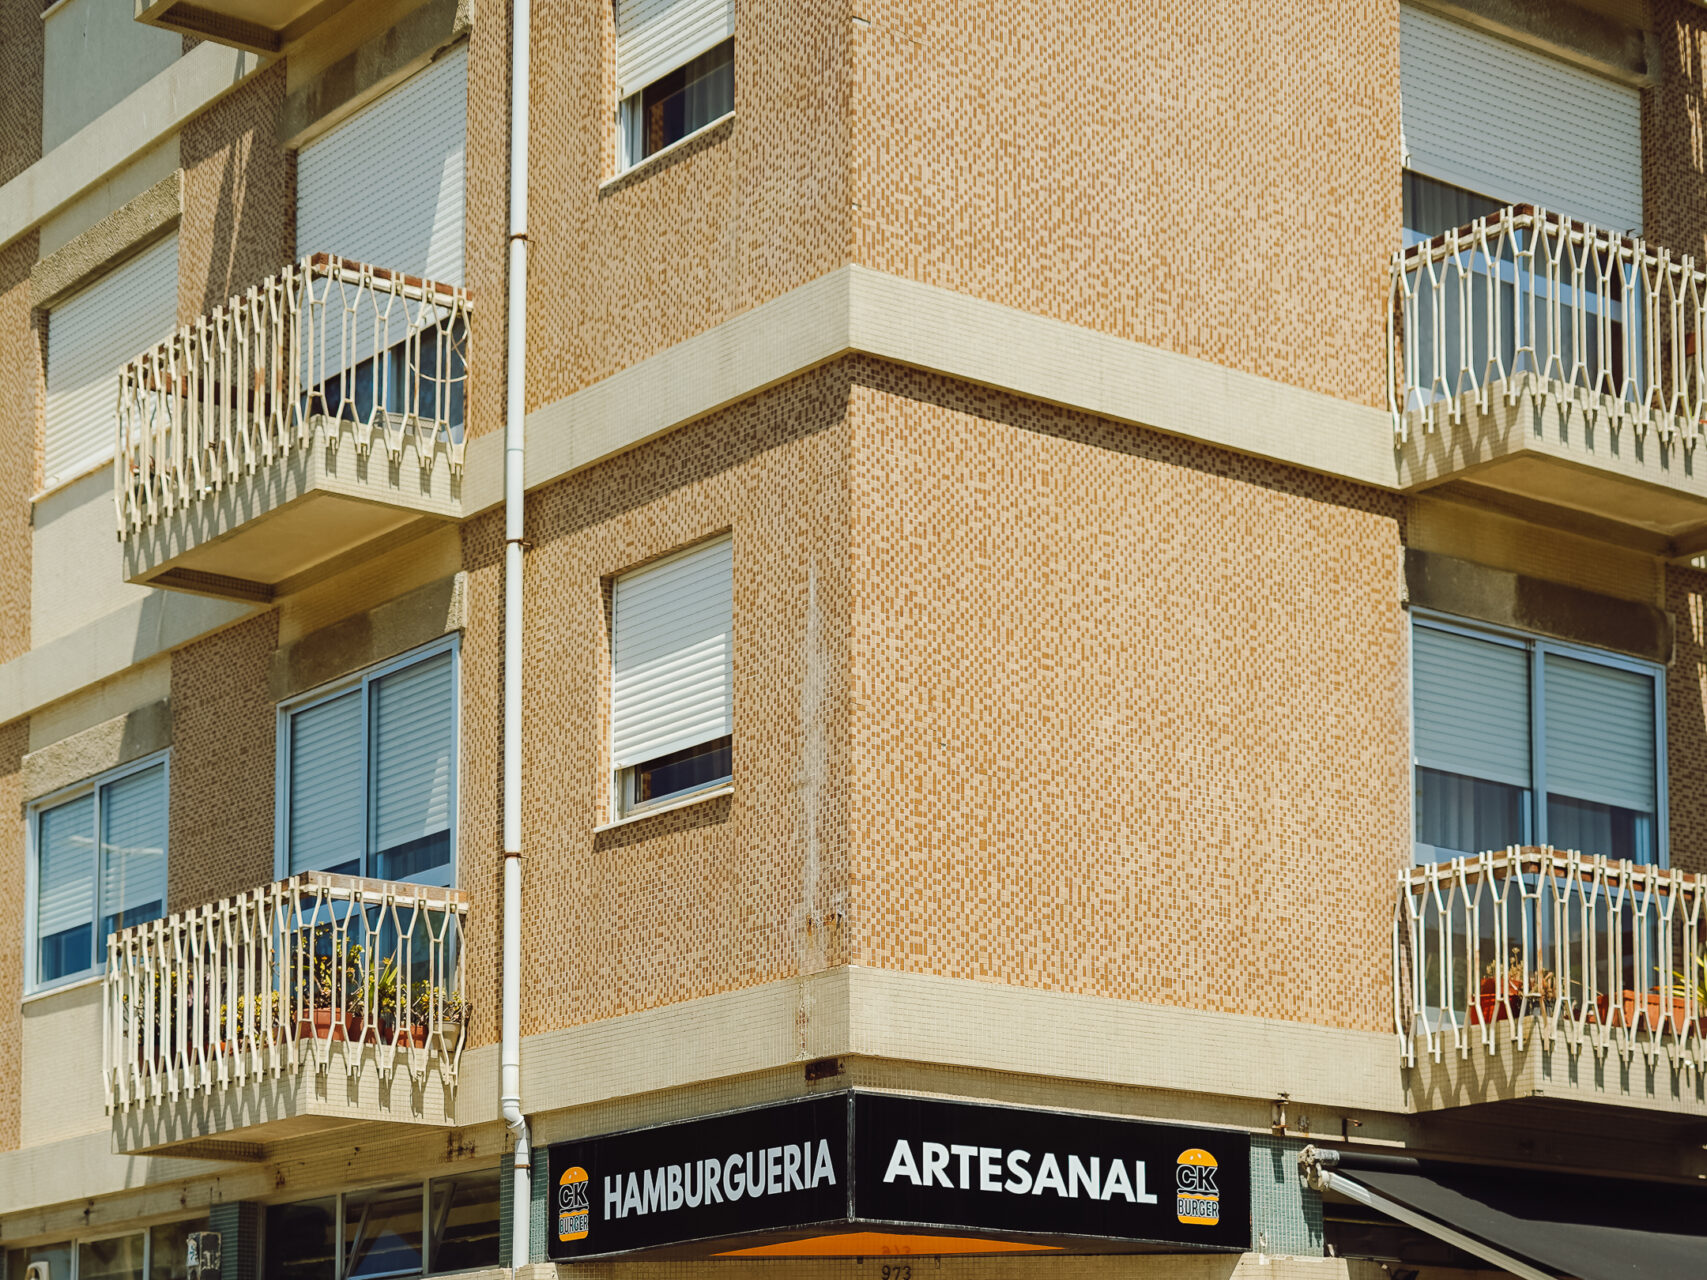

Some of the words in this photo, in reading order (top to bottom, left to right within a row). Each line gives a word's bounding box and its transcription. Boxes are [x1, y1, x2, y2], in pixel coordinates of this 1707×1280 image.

[604, 1139, 836, 1220] HAMBURGUERIA
[883, 1139, 1158, 1204] ARTESANAL
[1176, 1164, 1219, 1192] CK
[559, 1180, 589, 1209] CK
[1177, 1197, 1219, 1219] BURGER
[559, 1214, 589, 1235] BURGER
